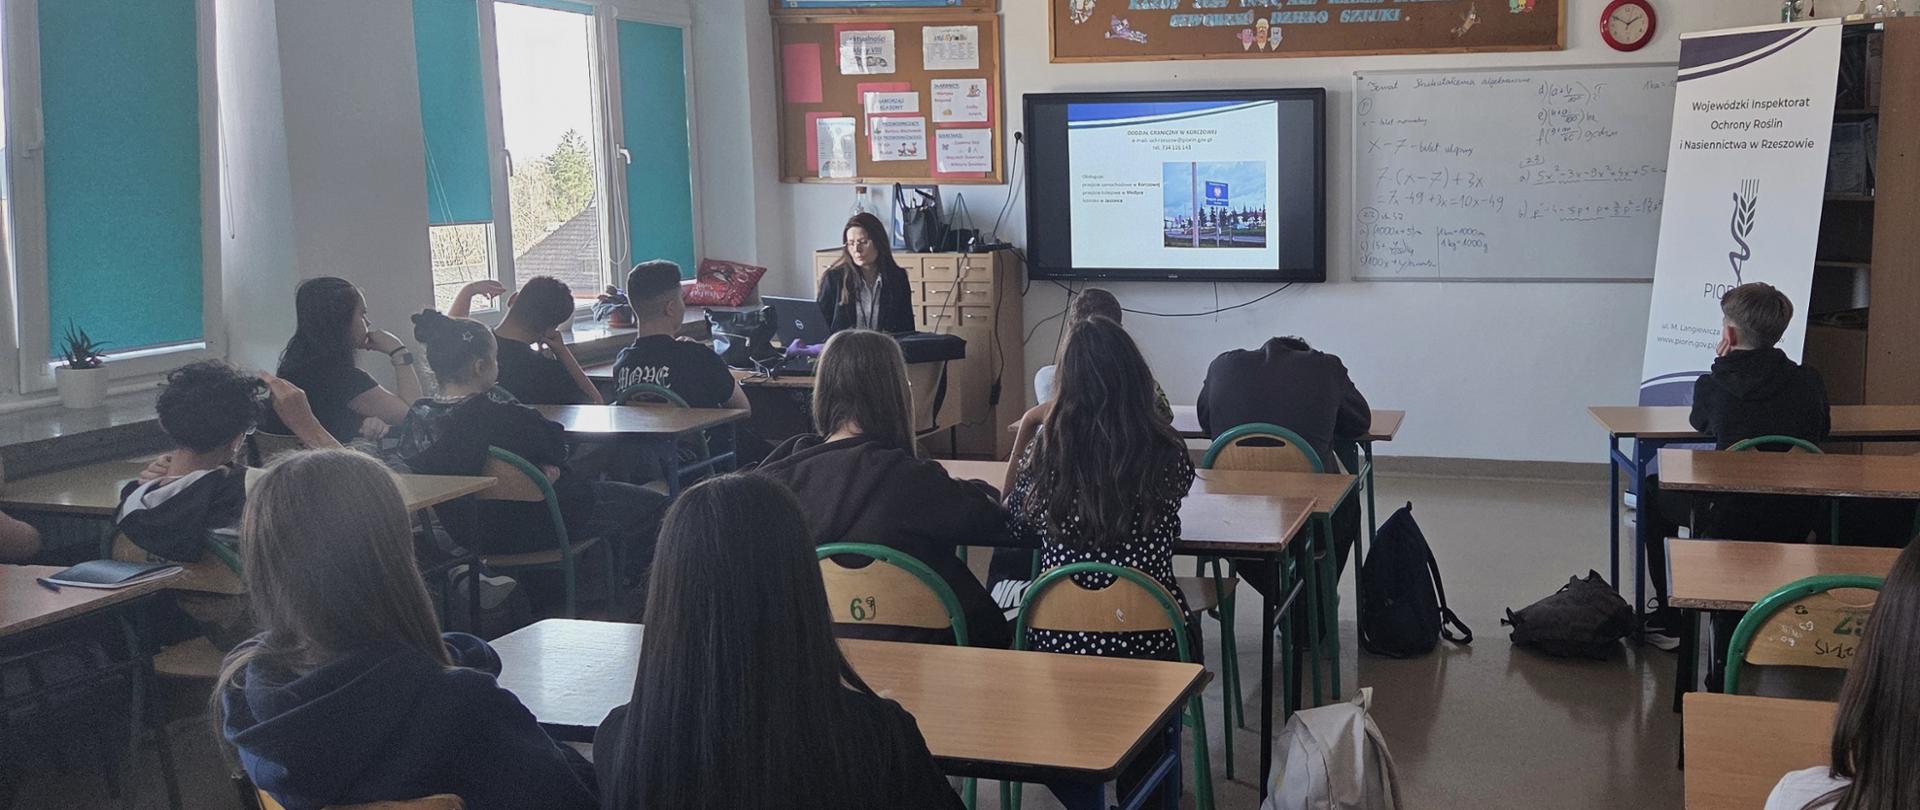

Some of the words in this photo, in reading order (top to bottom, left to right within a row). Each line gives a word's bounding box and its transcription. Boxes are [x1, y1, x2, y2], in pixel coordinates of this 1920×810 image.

[1692, 98, 1750, 112] Wojewódzki
[1751, 97, 1811, 110] Inspektorat
[1711, 119, 1751, 131] Ochrony
[1753, 118, 1783, 129] Roślin
[1684, 139, 1747, 150] Nasiennictwa
[1749, 141, 1758, 149] w
[1760, 137, 1815, 149] Rzeszowie
